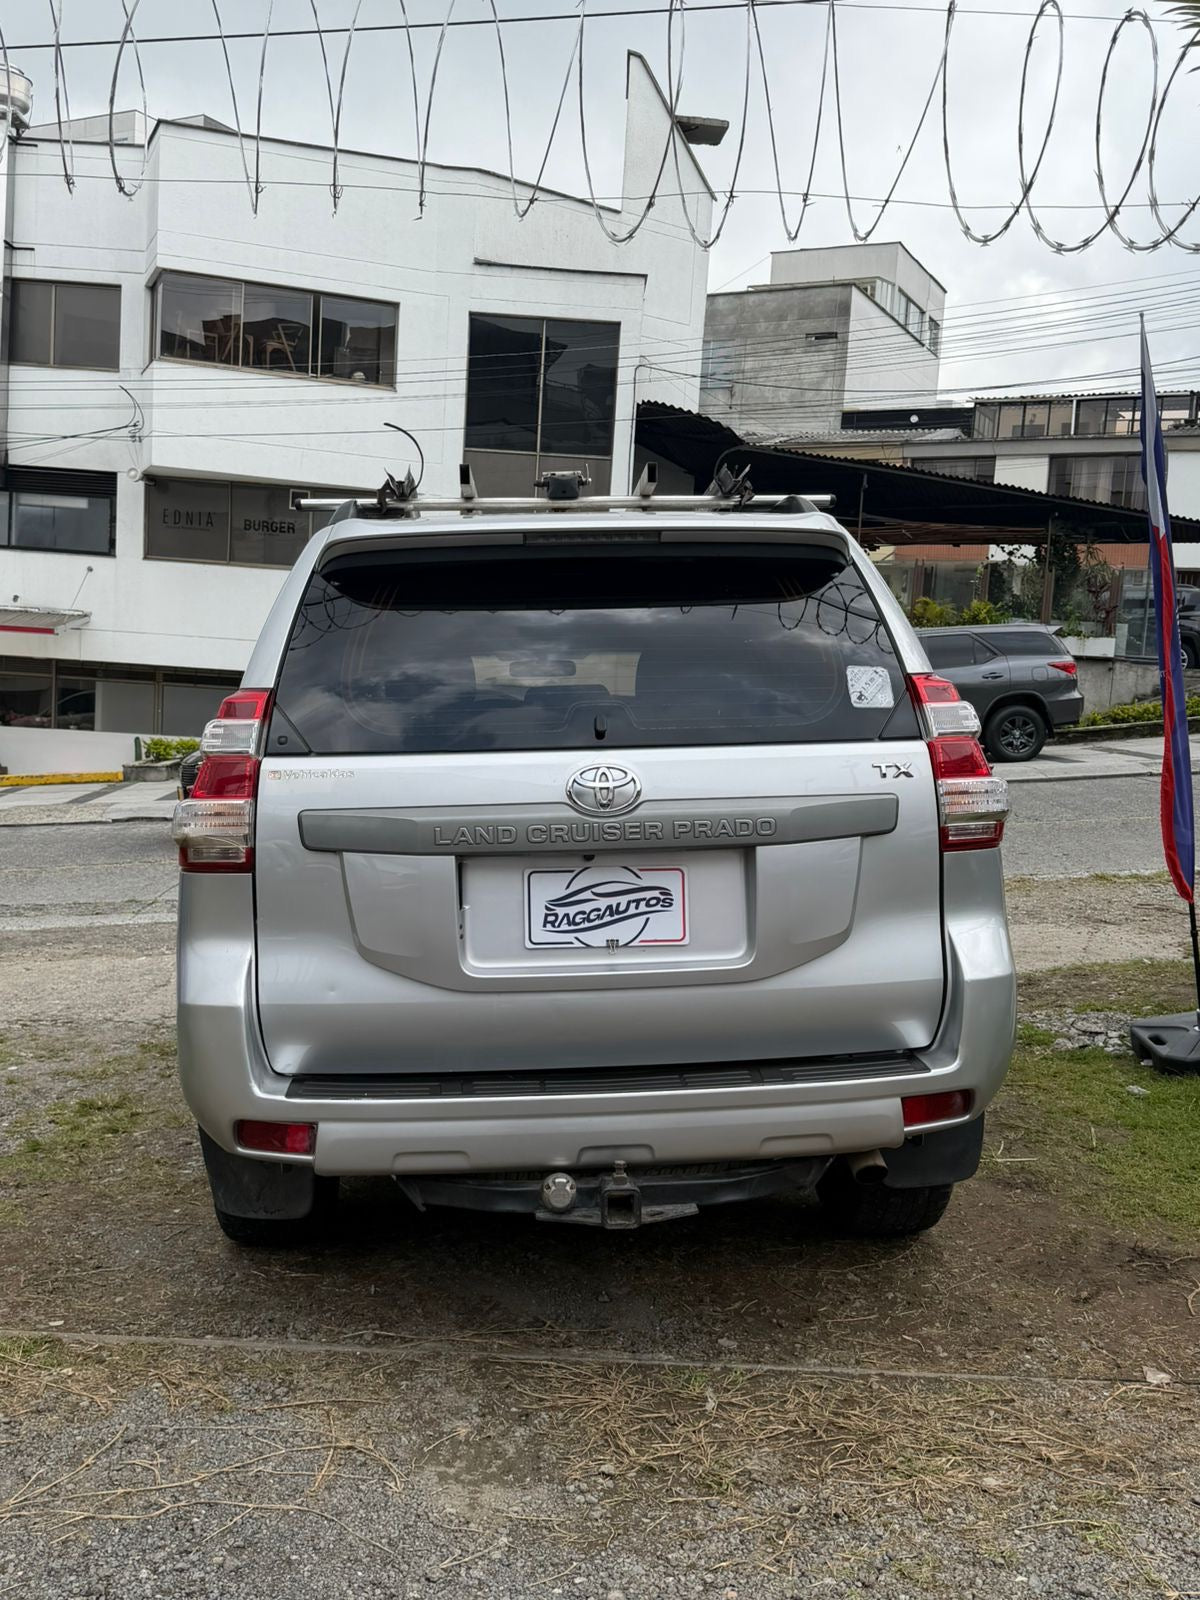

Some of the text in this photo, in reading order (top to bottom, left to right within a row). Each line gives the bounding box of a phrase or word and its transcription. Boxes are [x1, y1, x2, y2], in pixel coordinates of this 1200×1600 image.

[243, 518, 296, 534] BURGER
[871, 762, 914, 779] TX
[433, 817, 778, 847] LAND CRUISER PRADO
[542, 896, 675, 929] RAGGAUTOS
